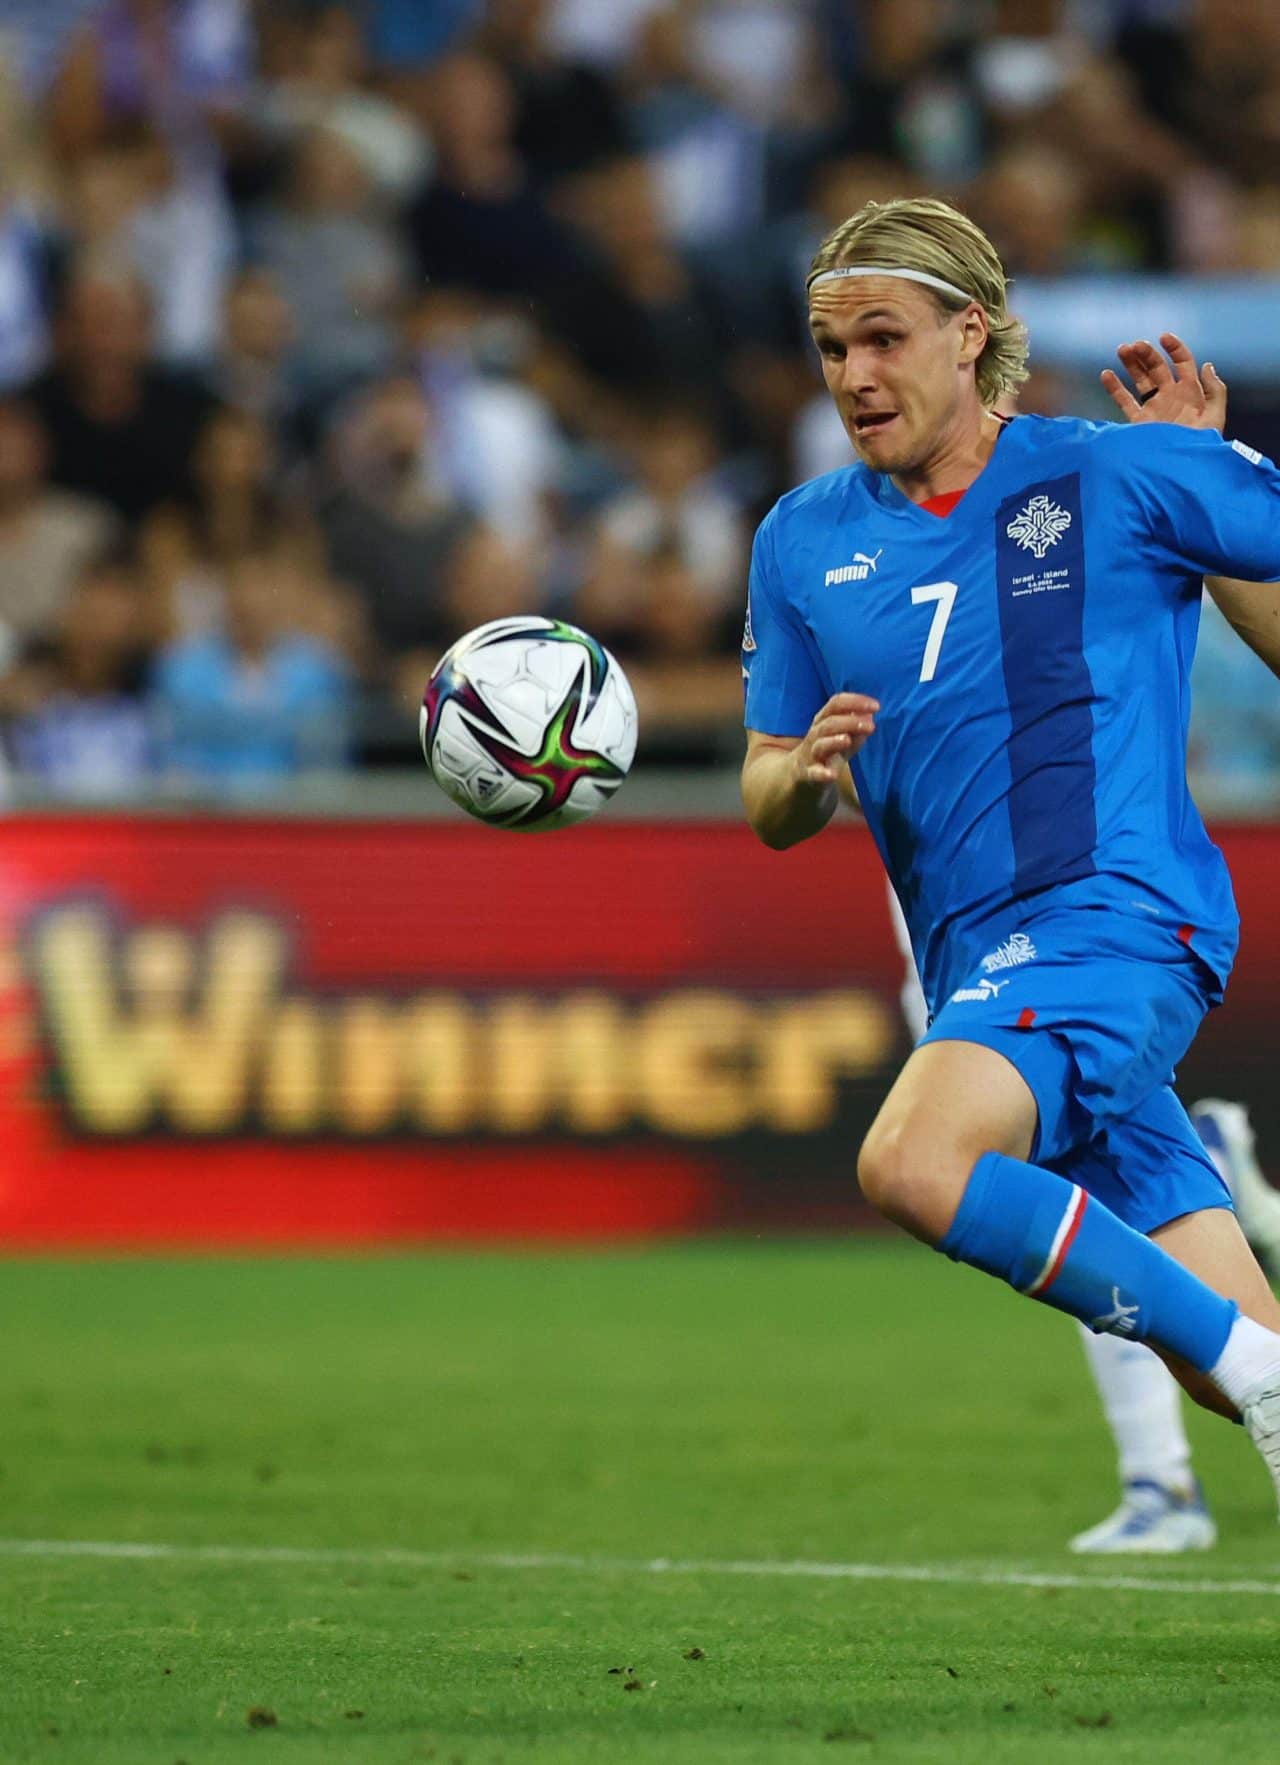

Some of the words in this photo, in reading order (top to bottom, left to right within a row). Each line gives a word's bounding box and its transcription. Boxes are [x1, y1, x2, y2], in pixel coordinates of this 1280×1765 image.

[825, 565, 869, 587] PUMA
[911, 581, 958, 683] 7
[35, 905, 885, 1135] Winner
